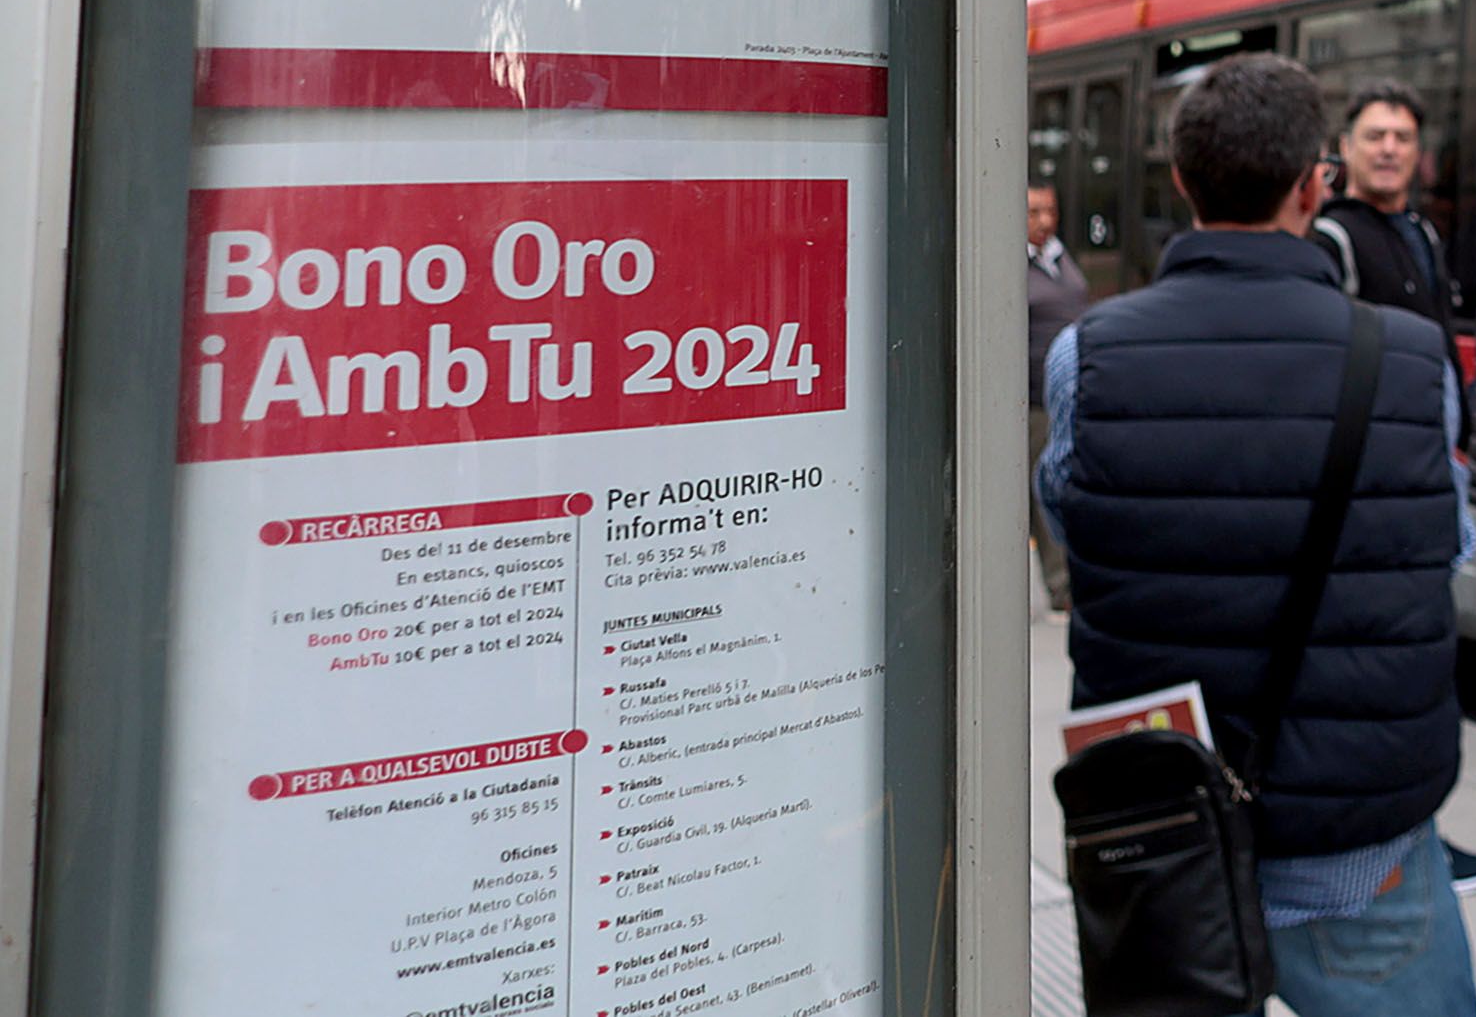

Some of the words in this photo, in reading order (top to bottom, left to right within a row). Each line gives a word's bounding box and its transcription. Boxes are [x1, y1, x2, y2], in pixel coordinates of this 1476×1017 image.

[204, 229, 466, 314] Bono
[493, 220, 655, 300] Oro
[198, 334, 227, 424] i
[242, 323, 593, 421] AmbTu
[623, 321, 821, 395] 2024
[608, 489, 650, 511] Per
[659, 466, 823, 506] ADQUIRIR-HO
[607, 509, 723, 541] informa't
[732, 507, 767, 526] en:
[382, 548, 411, 561] Des
[417, 543, 442, 558] del
[468, 539, 488, 552] de
[493, 532, 572, 550] desembre
[605, 552, 631, 567] Tel.
[637, 549, 655, 566] 96
[659, 547, 684, 563] 352
[712, 540, 726, 555] 78
[397, 572, 416, 586] En
[423, 567, 489, 582] estancs,
[495, 558, 564, 577] quioscos
[605, 573, 632, 588] Cita
[692, 551, 805, 576] www.valencia.es
[284, 613, 304, 623] en
[312, 608, 334, 620] les
[341, 601, 407, 617] Oficines
[413, 587, 491, 609] d'Atenció
[496, 586, 516, 599] de
[522, 579, 566, 597] l'EMT
[309, 634, 352, 647] Bono
[358, 628, 387, 641] Oro
[394, 622, 425, 637] 20€
[431, 620, 459, 636] per
[480, 614, 501, 627] tot
[507, 611, 521, 623] el
[526, 607, 563, 622] 2024
[604, 615, 647, 631] JUNTES
[652, 604, 722, 624] MUNICIPALS
[331, 653, 388, 671] AmbTu
[396, 648, 424, 663] 10€
[431, 646, 459, 662] per
[464, 644, 473, 654] a
[479, 639, 501, 652] tot
[506, 636, 520, 649] el
[526, 632, 563, 647] 2024
[620, 655, 652, 668] Plaça
[655, 648, 692, 662] Alfons
[696, 644, 706, 655] el
[621, 638, 655, 652] Ciutat
[659, 633, 687, 646] Vella
[619, 704, 684, 726] Provisional
[688, 702, 712, 714] Parc
[744, 692, 757, 703] de
[846, 671, 857, 681] de
[620, 677, 666, 693] Russafa
[619, 736, 666, 752] Abastos
[733, 726, 777, 747] principal
[780, 720, 813, 735] Mercat
[291, 771, 333, 792] PER
[339, 768, 355, 787] A
[360, 749, 480, 783] QUALSEVOL
[486, 738, 552, 764] DUBTE
[327, 804, 382, 821] Telèfon
[387, 792, 444, 812] Atenció
[450, 794, 458, 803] a
[464, 788, 476, 800] la
[482, 774, 559, 797] Ciutadania
[638, 791, 675, 806] Comte
[471, 809, 488, 825] 96
[494, 805, 517, 822] 315
[522, 801, 539, 815] 85
[544, 799, 558, 811] 15
[618, 816, 674, 837] Exposició
[636, 831, 682, 850] Guardia
[501, 844, 558, 863] Oficines
[473, 870, 544, 891] Mendoza,
[616, 864, 659, 882] Patraix
[637, 879, 664, 894] Beat
[667, 869, 711, 887] Nicolau
[715, 859, 750, 875] Factor,
[406, 908, 463, 927] Interior
[468, 899, 511, 915] Metro
[516, 888, 556, 906] Colón
[435, 929, 474, 945] Plaça
[480, 923, 498, 936] de
[636, 920, 687, 939] Barraca,
[397, 938, 555, 978] www.emtvalencia.es
[615, 955, 655, 972] Pobles
[659, 946, 677, 961] del
[681, 938, 709, 955] Nord
[501, 964, 554, 985] Xarxes:
[615, 974, 646, 989] Plaza
[650, 964, 669, 980] del
[672, 956, 714, 974] Pobles,
[405, 983, 556, 1017] emtvalencia
[614, 1000, 654, 1017] Pobles
[658, 991, 676, 1005] del
[680, 984, 705, 999] Oest
[675, 995, 723, 1017] Secanet,
